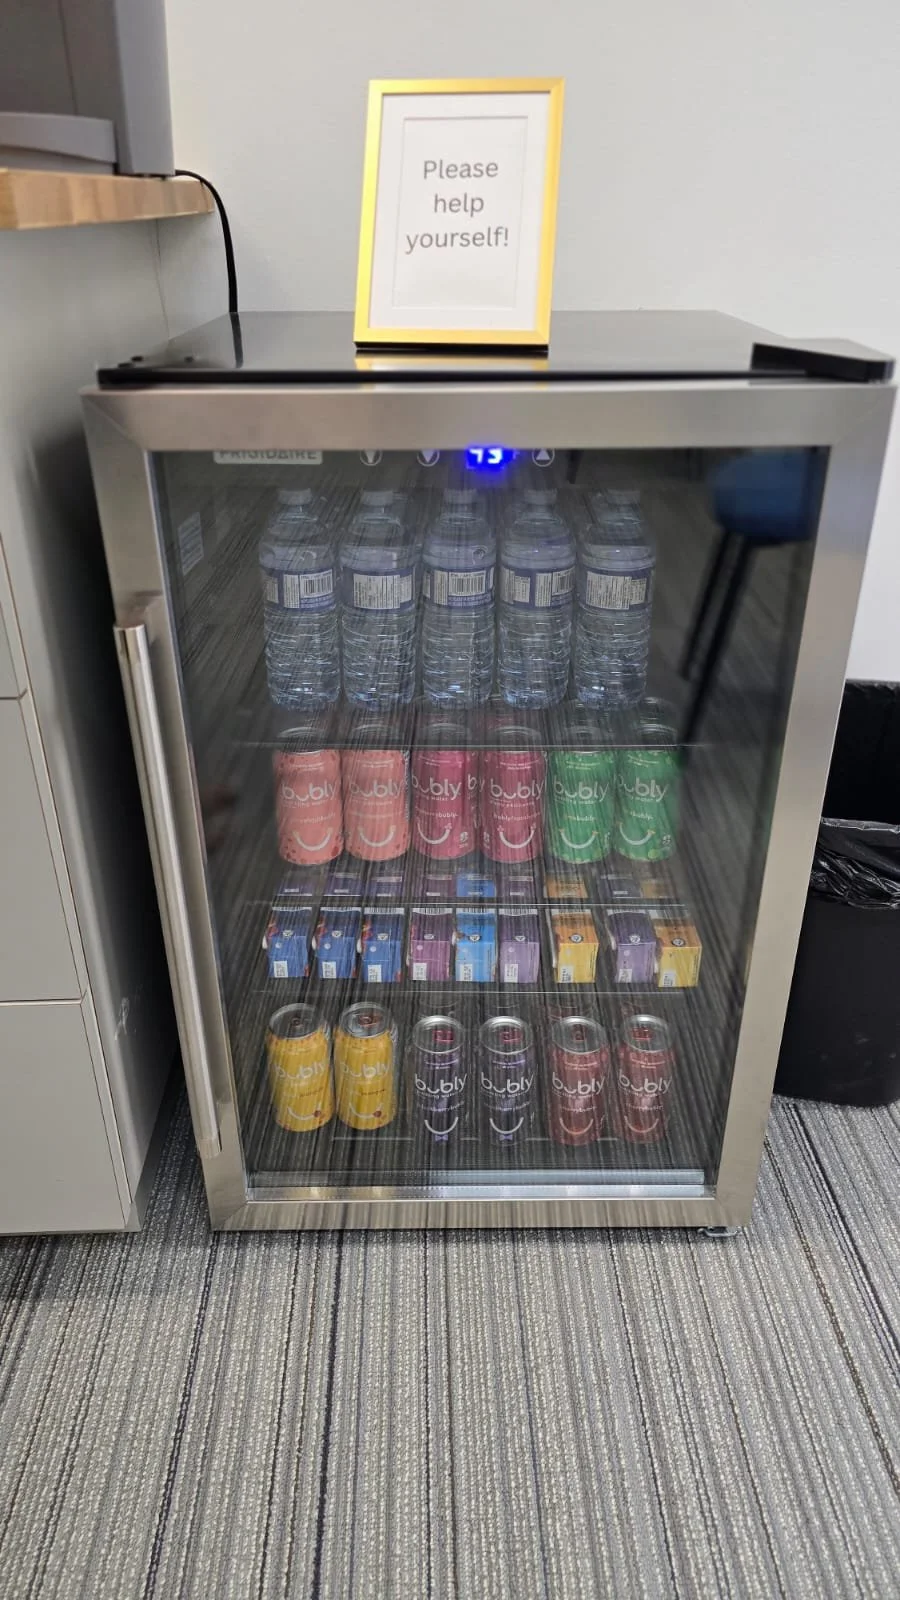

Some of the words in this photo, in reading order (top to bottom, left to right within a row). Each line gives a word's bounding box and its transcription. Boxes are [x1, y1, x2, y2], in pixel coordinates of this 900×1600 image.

[423, 159, 499, 180] Please
[434, 193, 485, 218] help
[404, 226, 509, 255] yourself!
[282, 780, 336, 801] bubly
[349, 778, 402, 799] bubly
[490, 778, 545, 800] bubly
[554, 776, 609, 802] bubly
[414, 1073, 467, 1094] bubly
[481, 1071, 534, 1094] bubly
[552, 1071, 605, 1095] bubly
[619, 1068, 672, 1094] bubly
